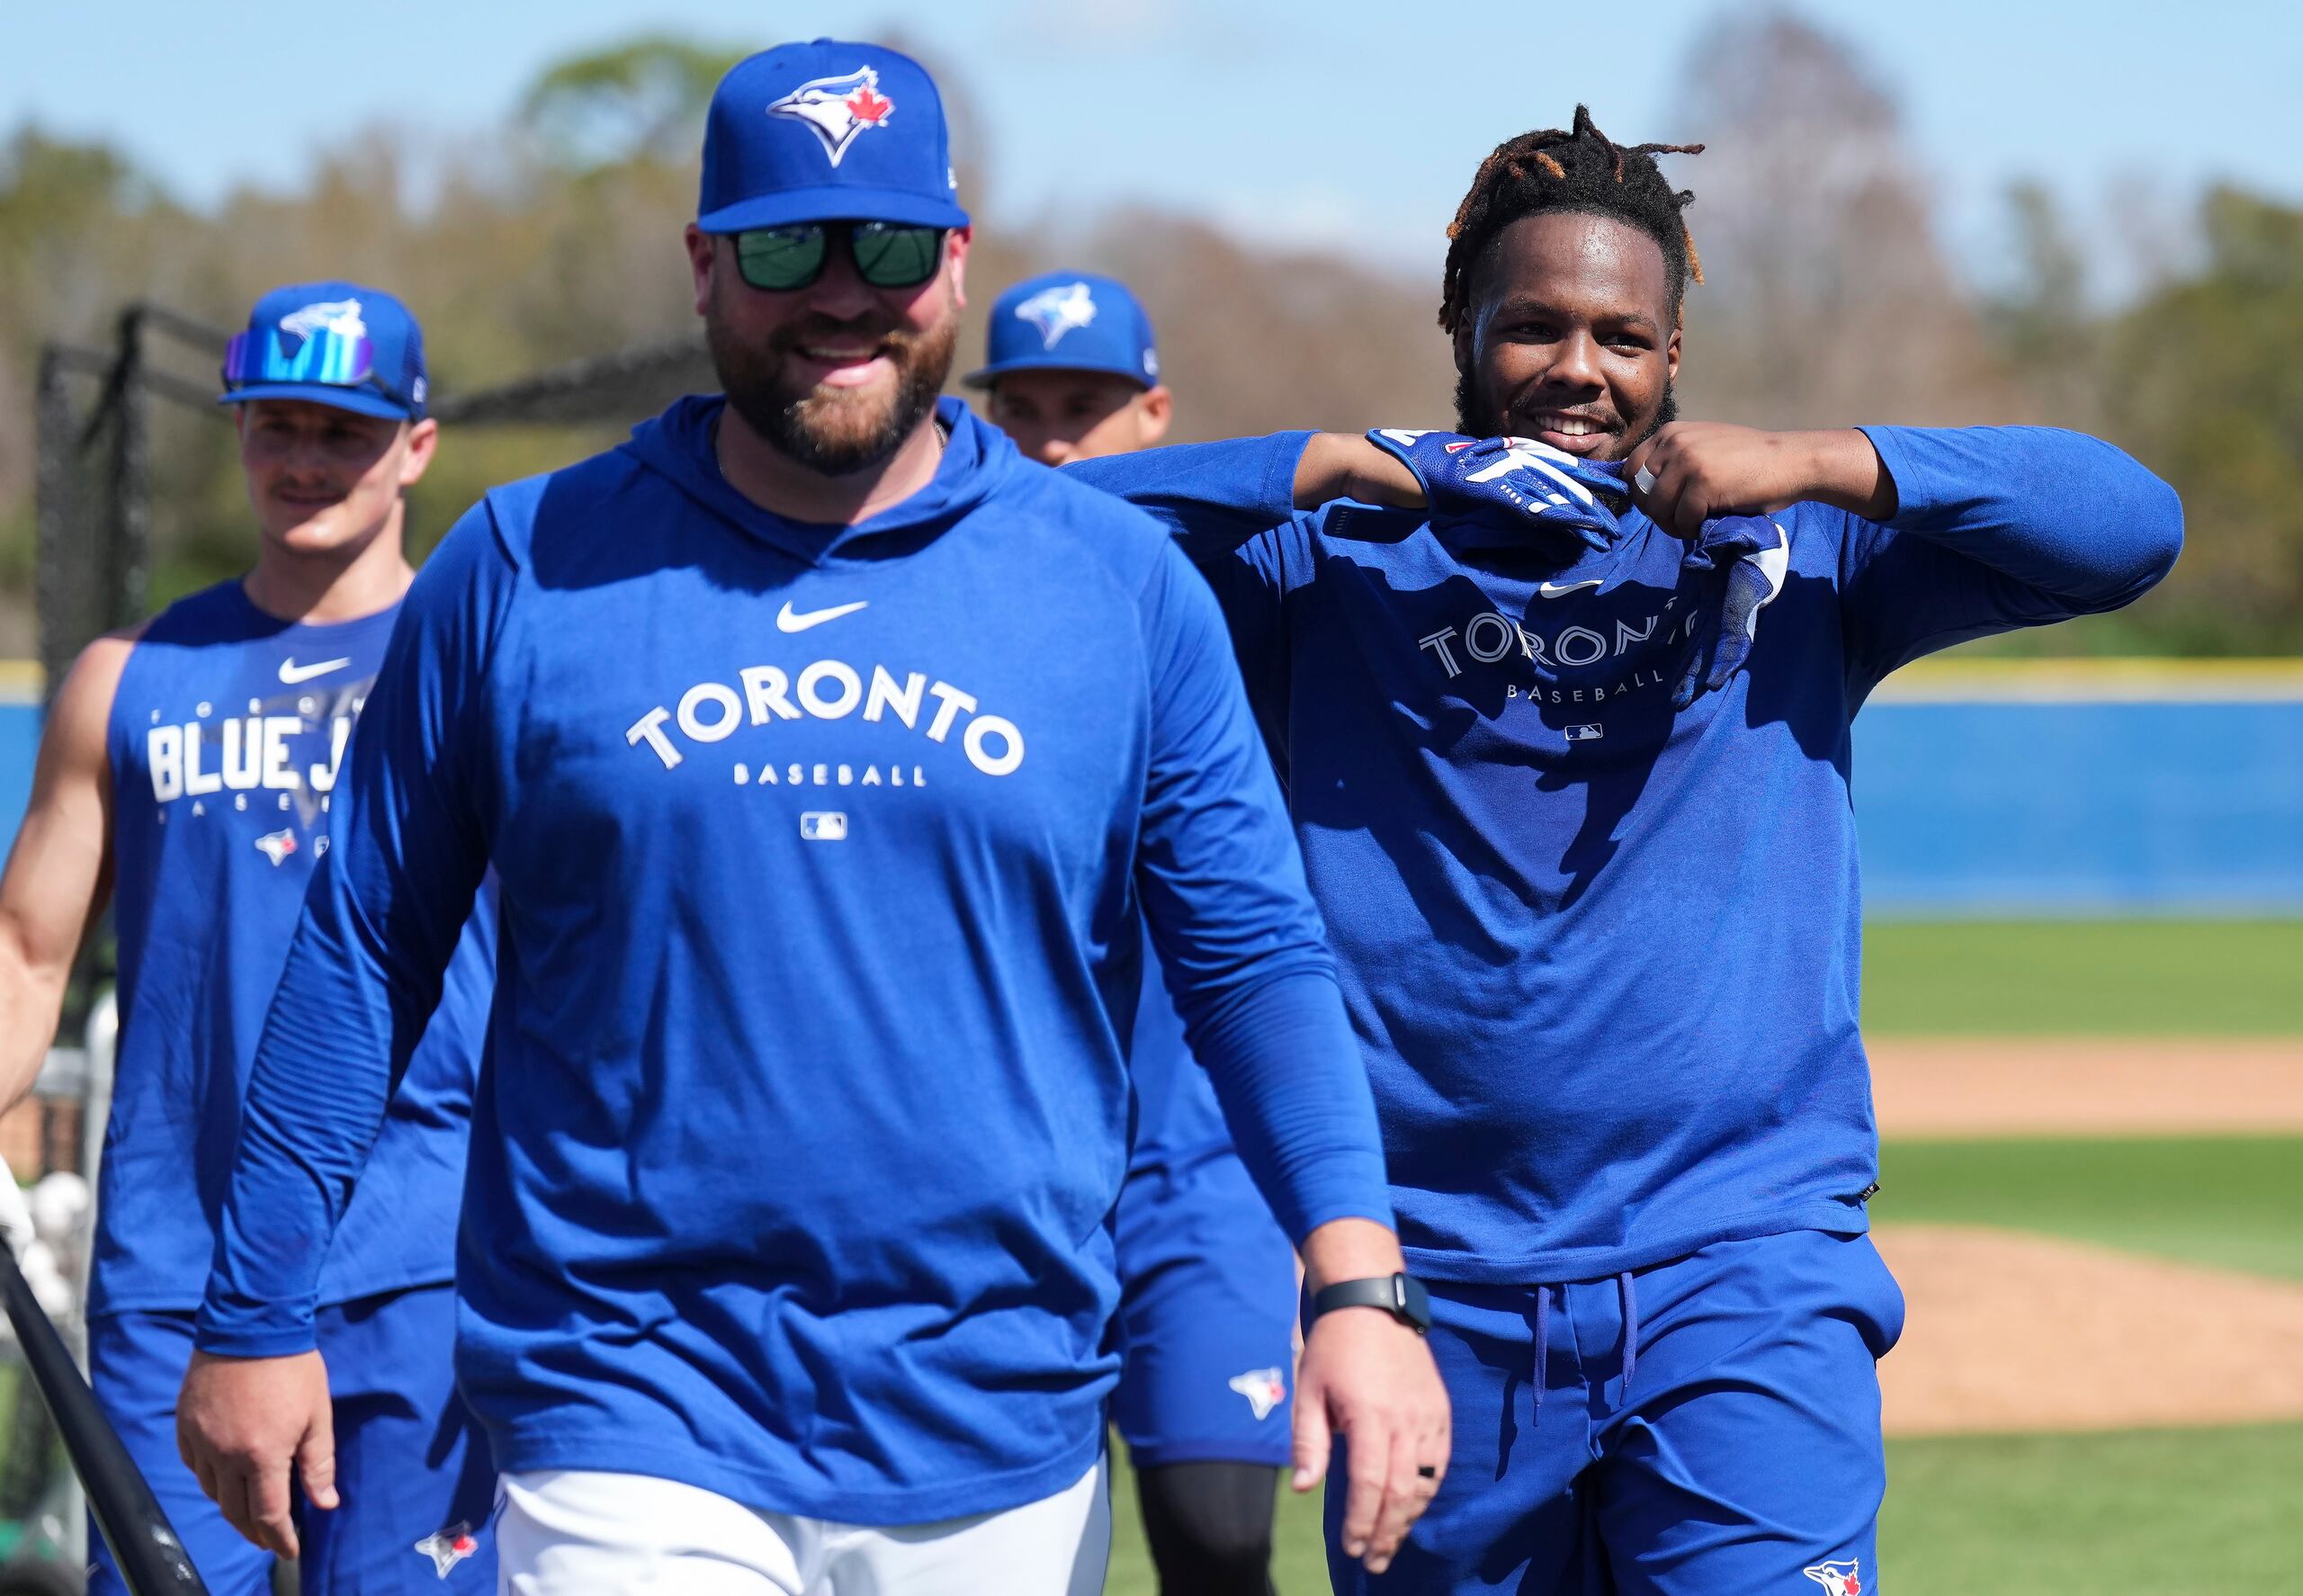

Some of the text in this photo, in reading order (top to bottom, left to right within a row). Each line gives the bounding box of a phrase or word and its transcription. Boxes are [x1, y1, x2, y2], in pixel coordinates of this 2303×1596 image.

[1419, 595, 1698, 679] TORON
[626, 659, 1025, 776] TORONTO
[1507, 669, 1663, 704] BASEBALL
[148, 717, 302, 802] BLUE
[734, 763, 927, 787] BASEBALL
